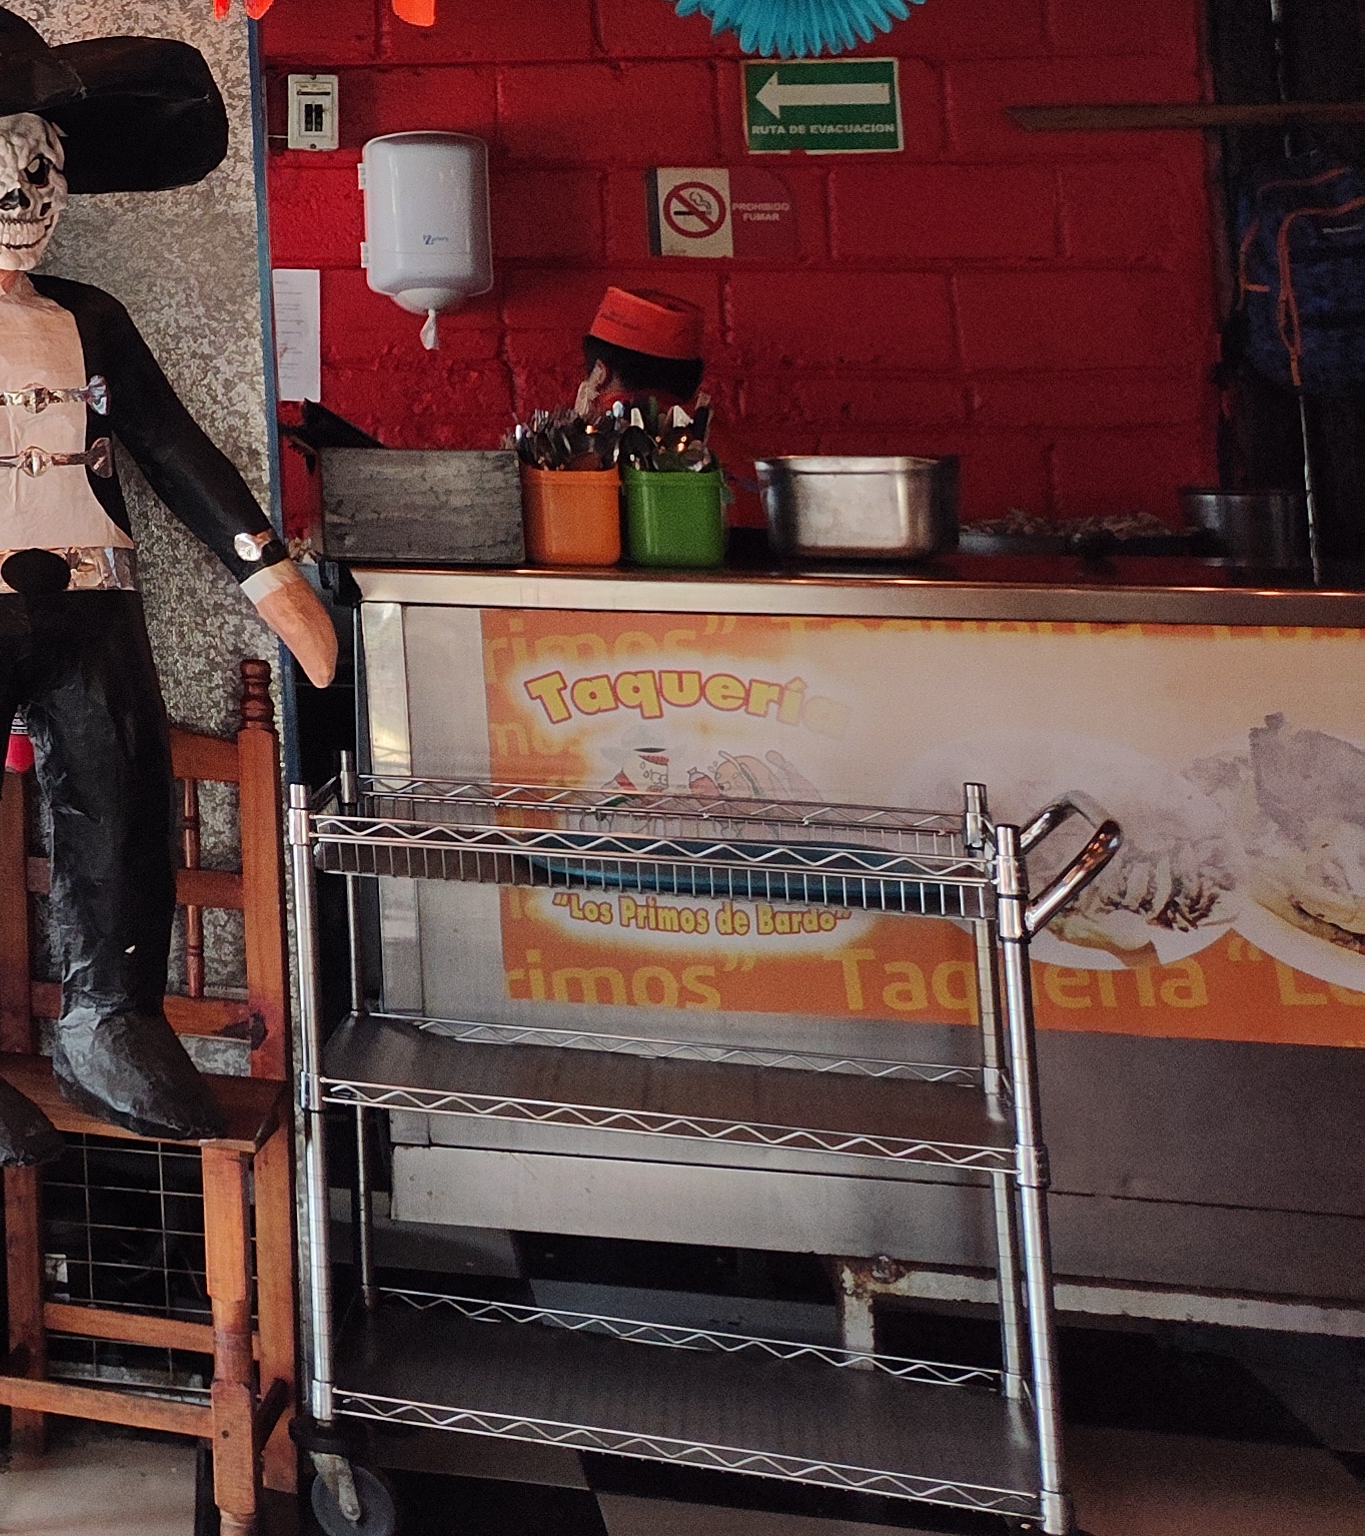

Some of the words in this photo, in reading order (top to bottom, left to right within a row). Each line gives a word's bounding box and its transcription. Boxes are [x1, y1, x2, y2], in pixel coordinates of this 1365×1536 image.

[752, 124, 786, 135] RUTA
[789, 124, 806, 135] DE
[742, 212, 780, 222] FUMAR
[619, 895, 709, 934] Primos
[715, 902, 751, 936] de
